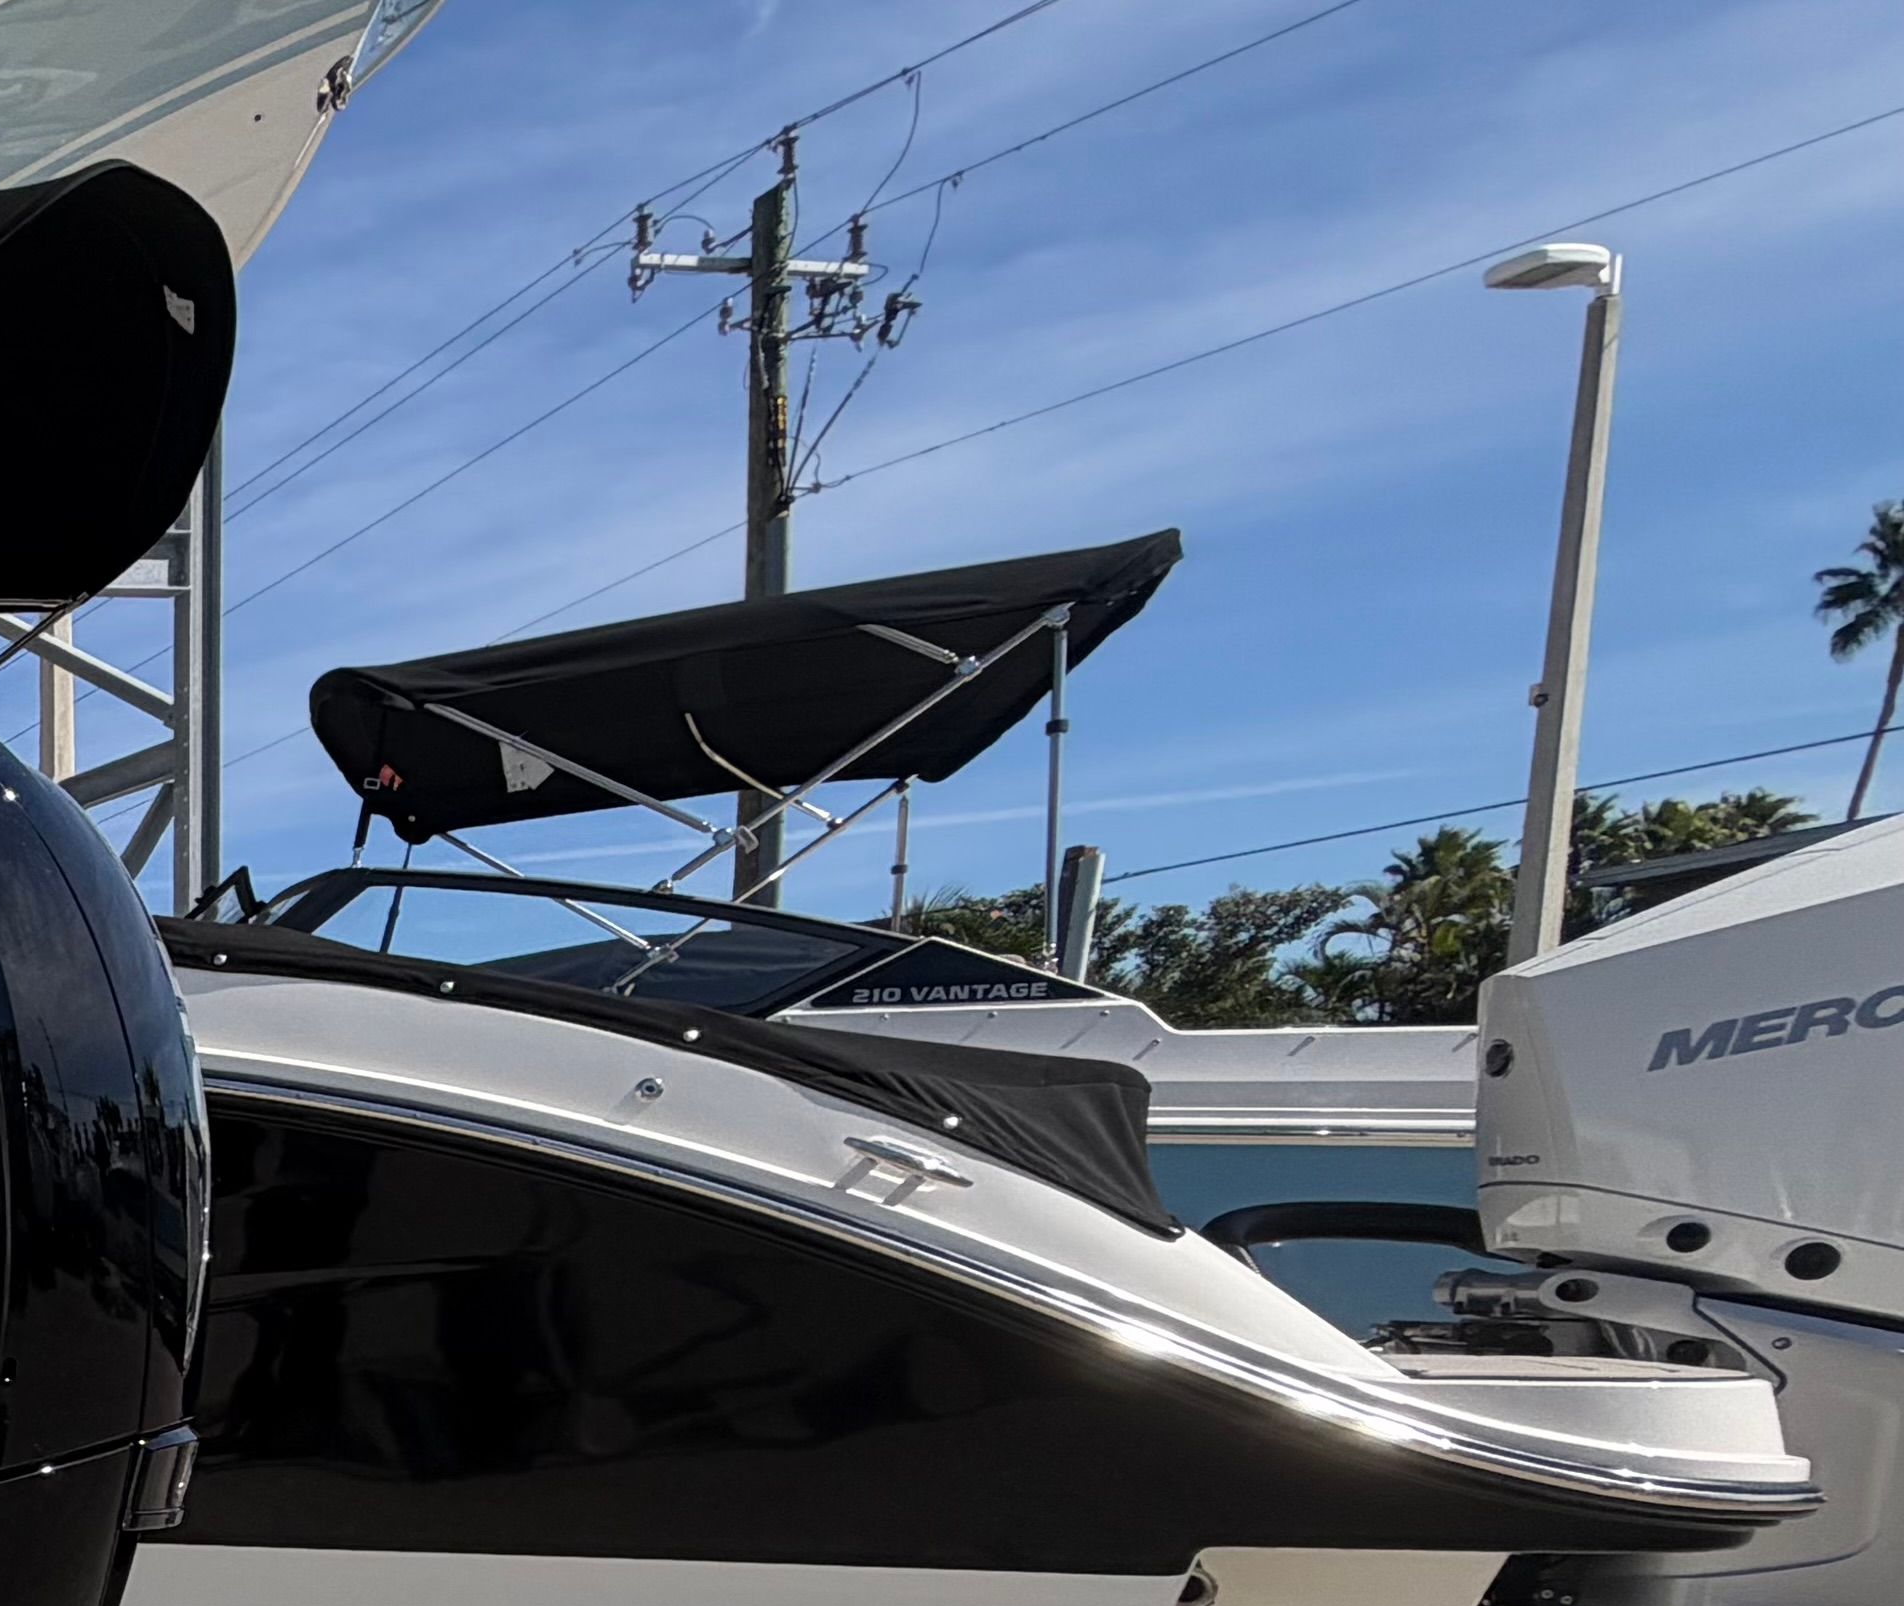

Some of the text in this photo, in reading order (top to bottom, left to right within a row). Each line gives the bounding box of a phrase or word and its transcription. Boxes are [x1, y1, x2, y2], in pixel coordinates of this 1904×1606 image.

[852, 981, 1049, 1004] 210 VANTAGE
[1646, 984, 1904, 1072] MERC
